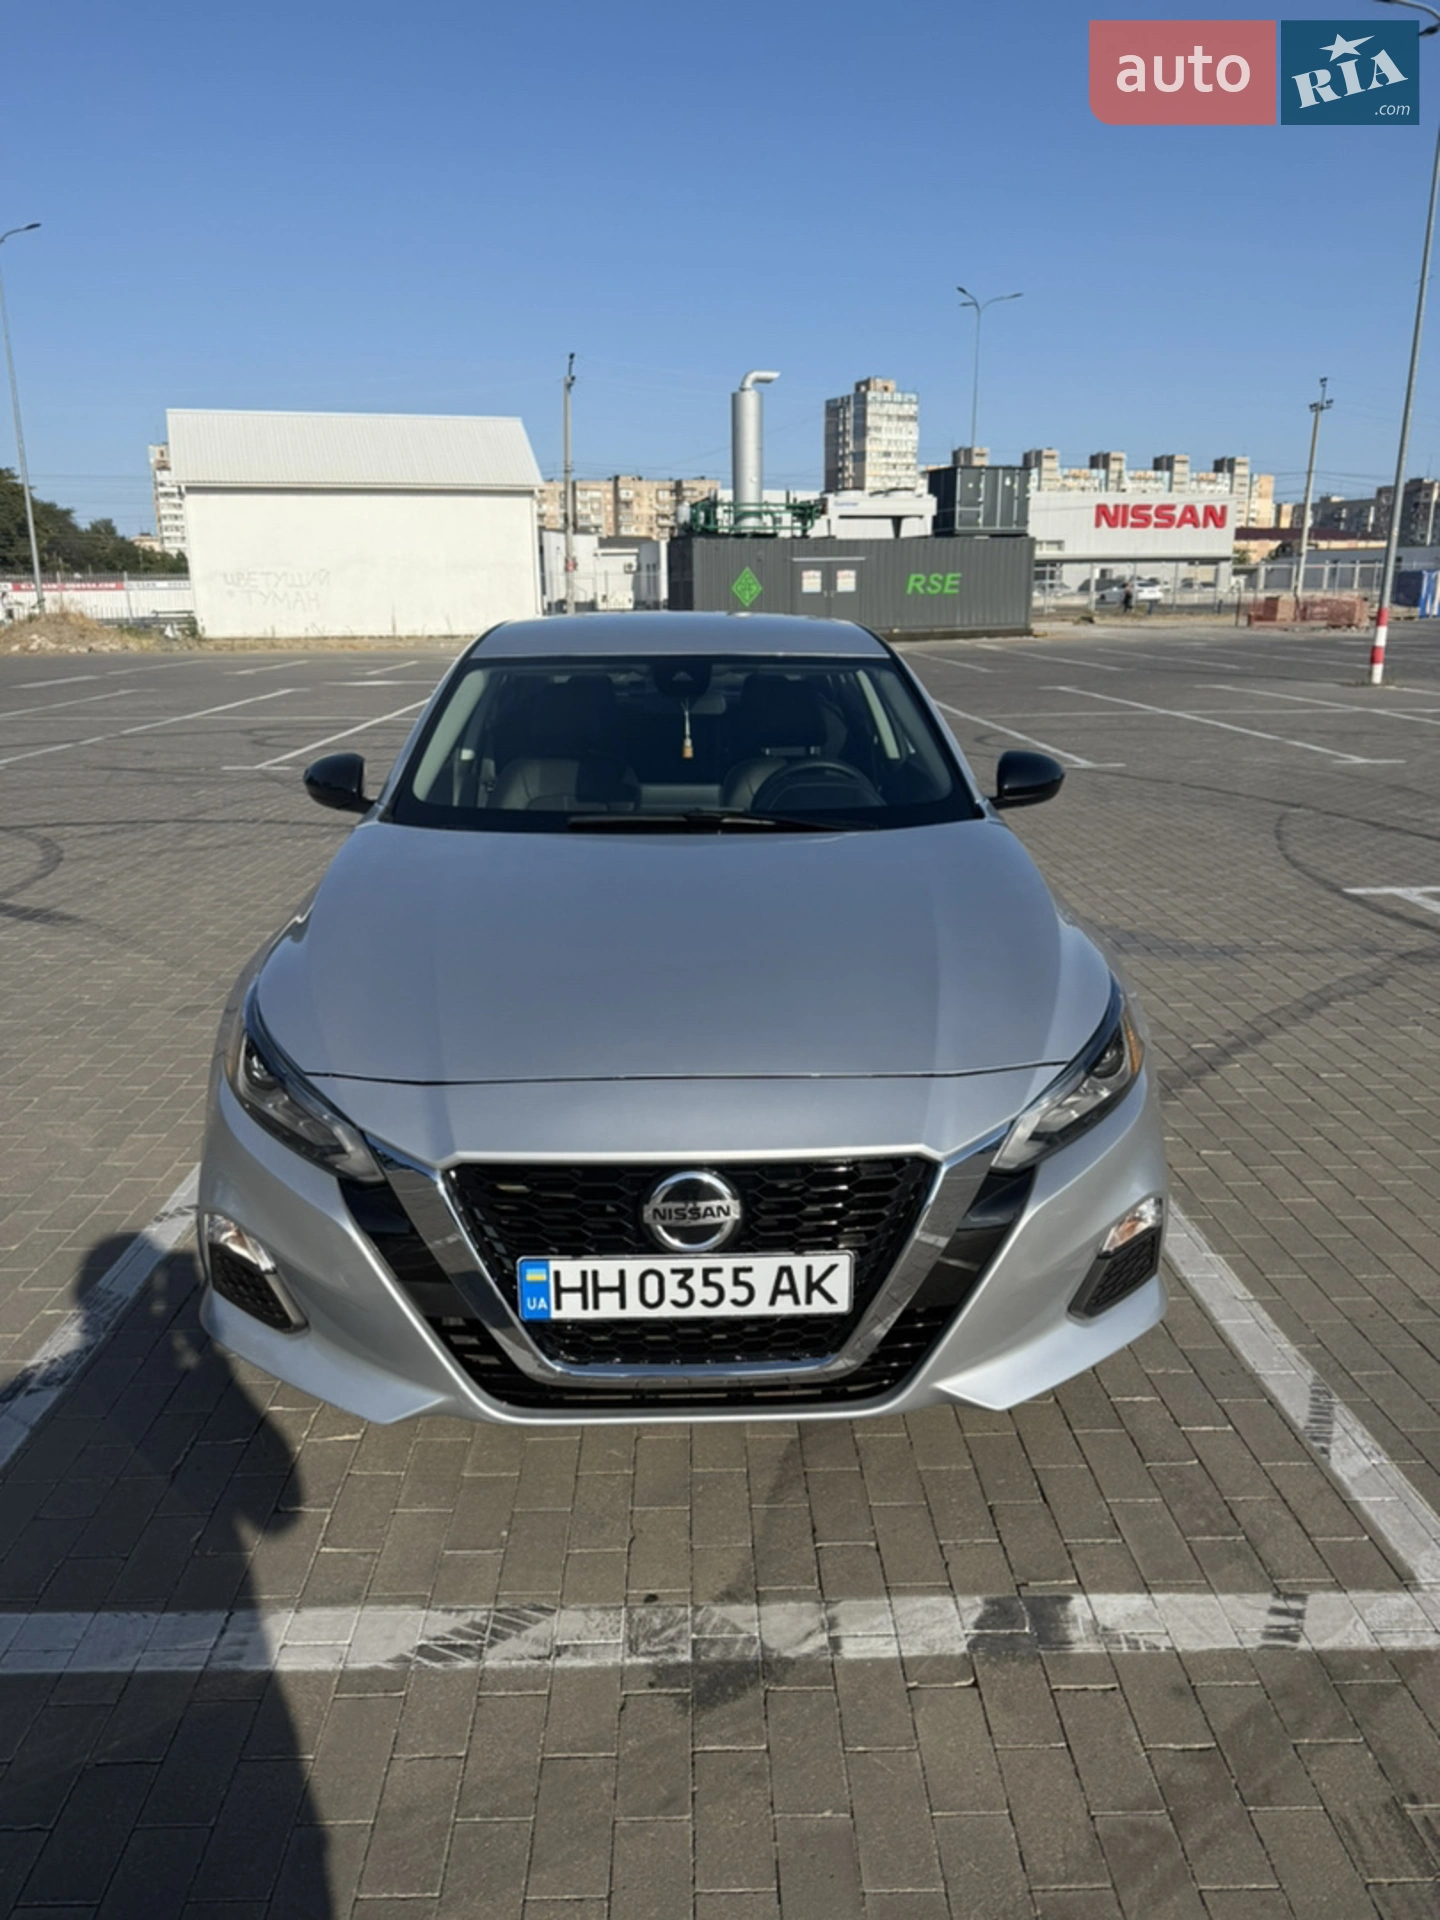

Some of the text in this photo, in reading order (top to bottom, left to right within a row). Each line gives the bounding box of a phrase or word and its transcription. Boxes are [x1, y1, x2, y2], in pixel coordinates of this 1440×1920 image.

[1095, 504, 1227, 529] NISSAN
[906, 573, 962, 595] RSE
[652, 1205, 731, 1221] NISSAN
[638, 1266, 756, 1309] 0355
[768, 1263, 840, 1307] AK
[527, 1296, 549, 1311] UA
